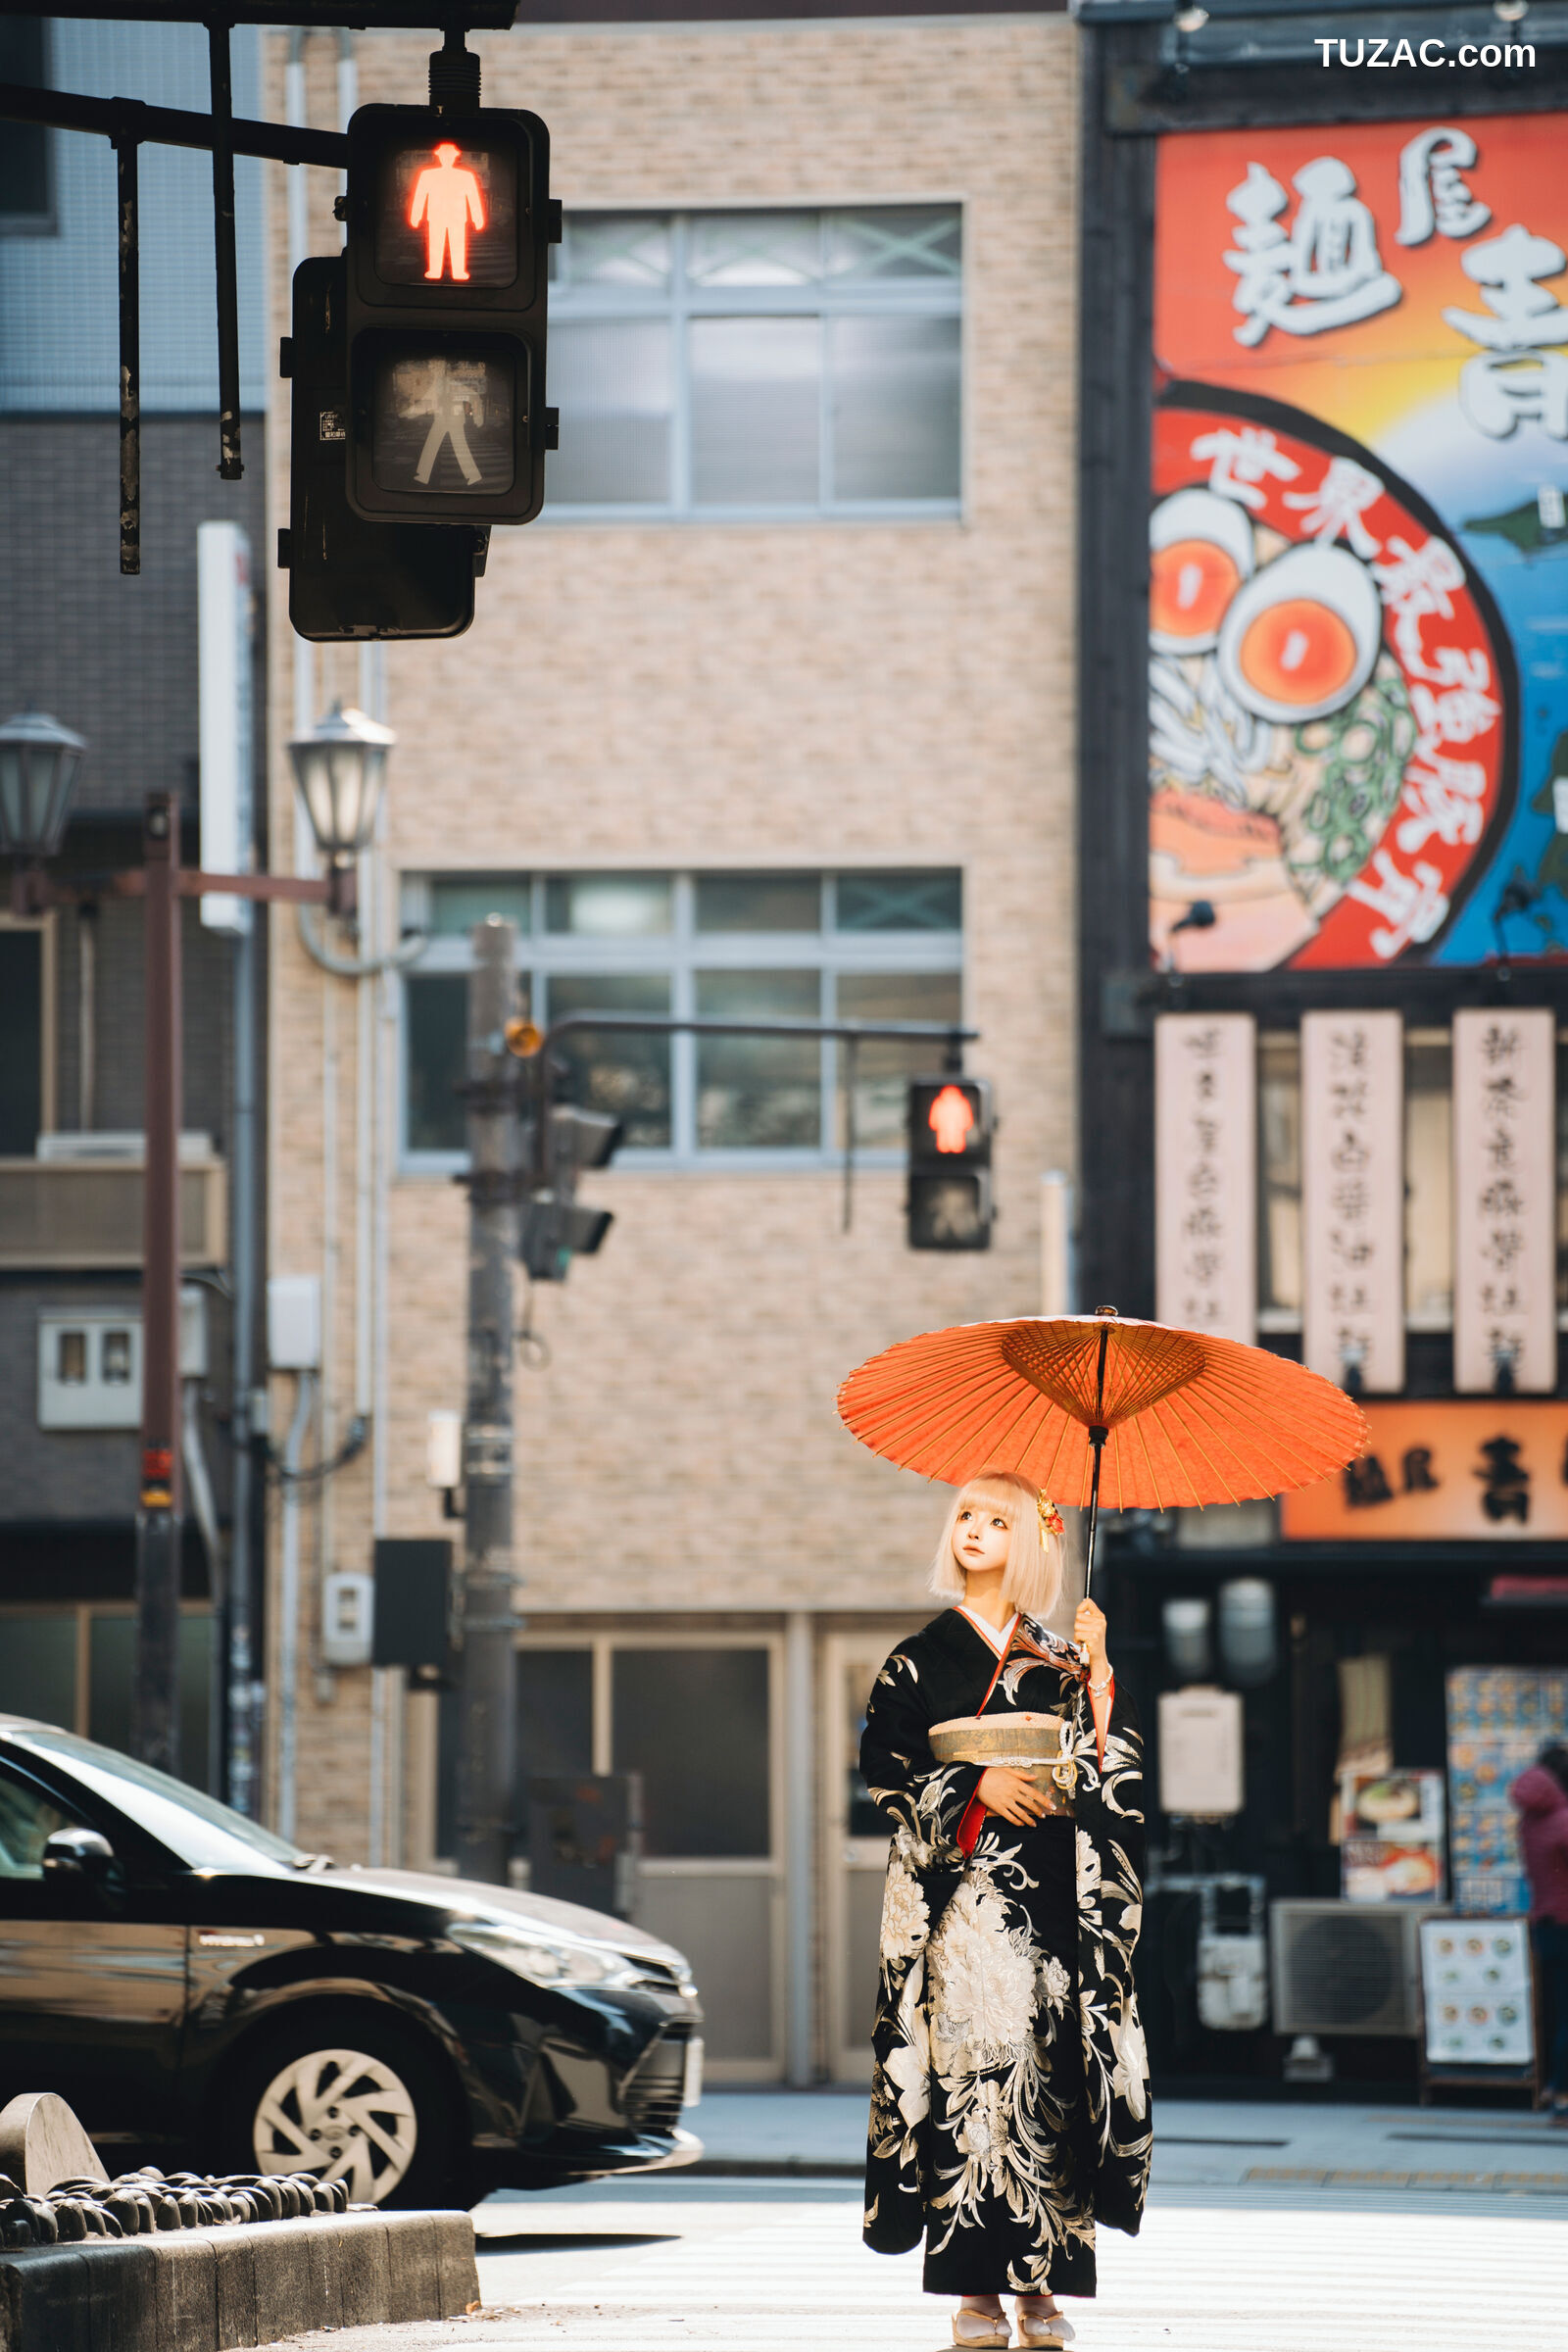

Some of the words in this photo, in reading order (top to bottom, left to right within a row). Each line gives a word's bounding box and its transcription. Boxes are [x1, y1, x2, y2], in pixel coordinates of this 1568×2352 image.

[1191, 426, 1501, 958] 世界最強豚骨
